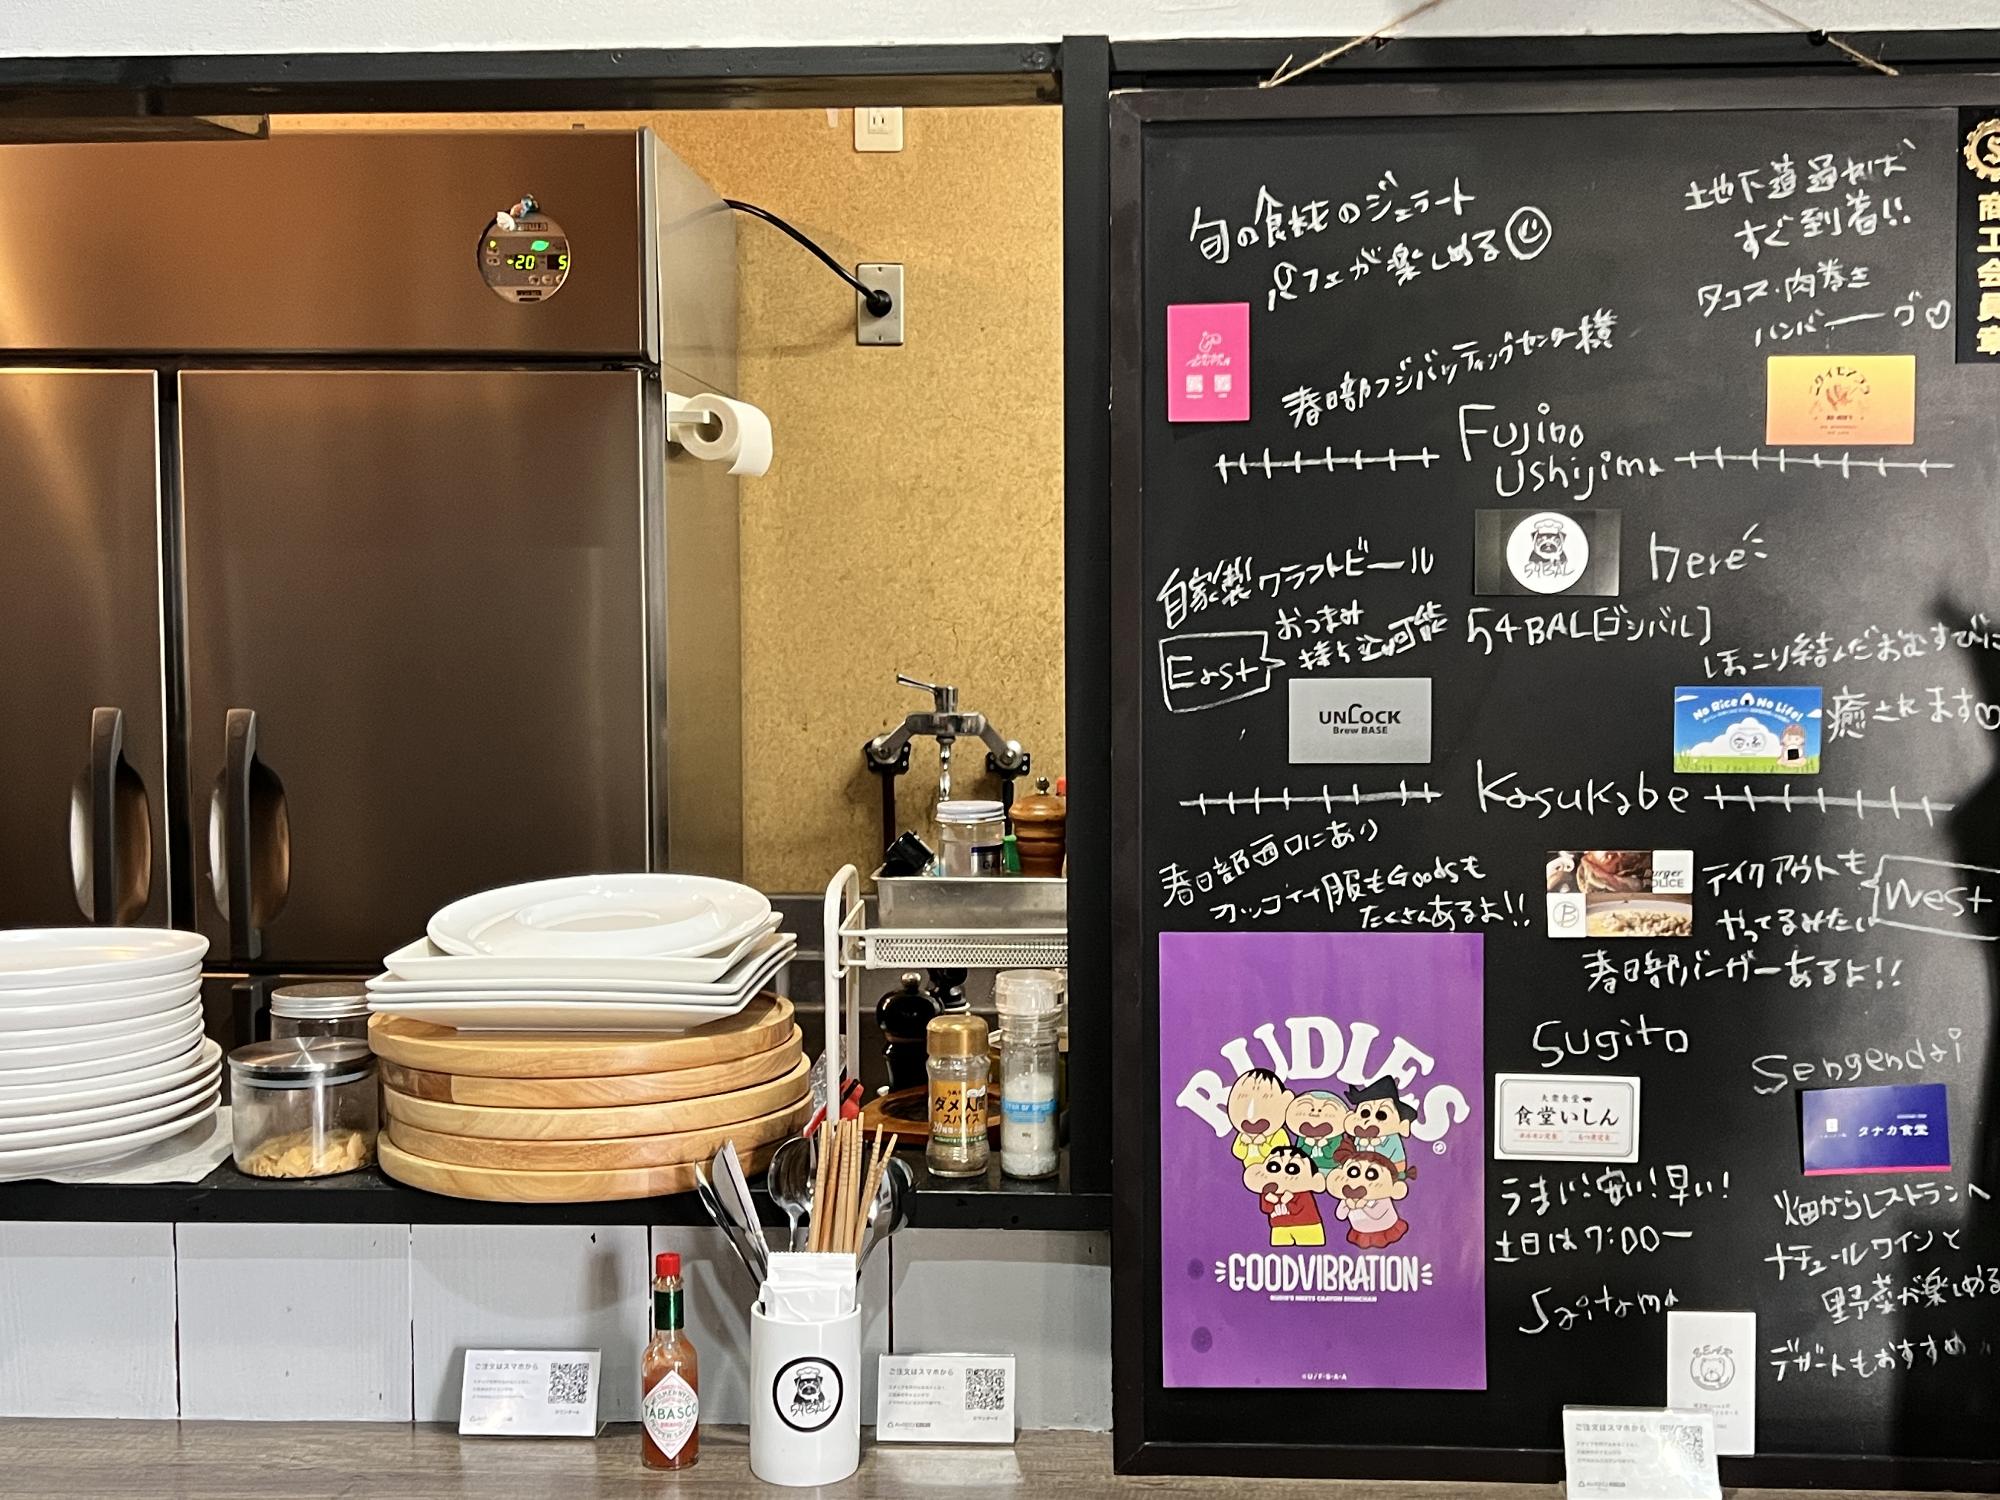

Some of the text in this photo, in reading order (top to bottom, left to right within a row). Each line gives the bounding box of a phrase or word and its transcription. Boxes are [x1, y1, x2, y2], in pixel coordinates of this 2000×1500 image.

[1458, 403, 1584, 462] Fujino
[1495, 450, 1665, 501] Ushijima
[1650, 531, 1746, 583] here
[1166, 655, 1259, 691] East
[1319, 703, 1401, 724] UNLOCK
[1692, 706, 1711, 721] No
[1711, 699, 1738, 713] Rice
[1756, 697, 1774, 709] No
[1774, 701, 1805, 722] Life!
[1333, 726, 1388, 735] Brew BASE
[1476, 759, 1690, 818] Kasukabe
[1158, 818, 1379, 907] 春日部西口にあり
[1885, 879, 1993, 917] West
[1532, 1014, 1689, 1068] Sugito
[1751, 1028, 1963, 1096] Sengendai
[1514, 1105, 1619, 1126] 食堂いしん
[1858, 1124, 1929, 1137] タナカ食堂
[1228, 1253, 1419, 1292] GOODVIBRATION
[1518, 1284, 1680, 1335] Saitama
[645, 1402, 696, 1420] TABASCO
